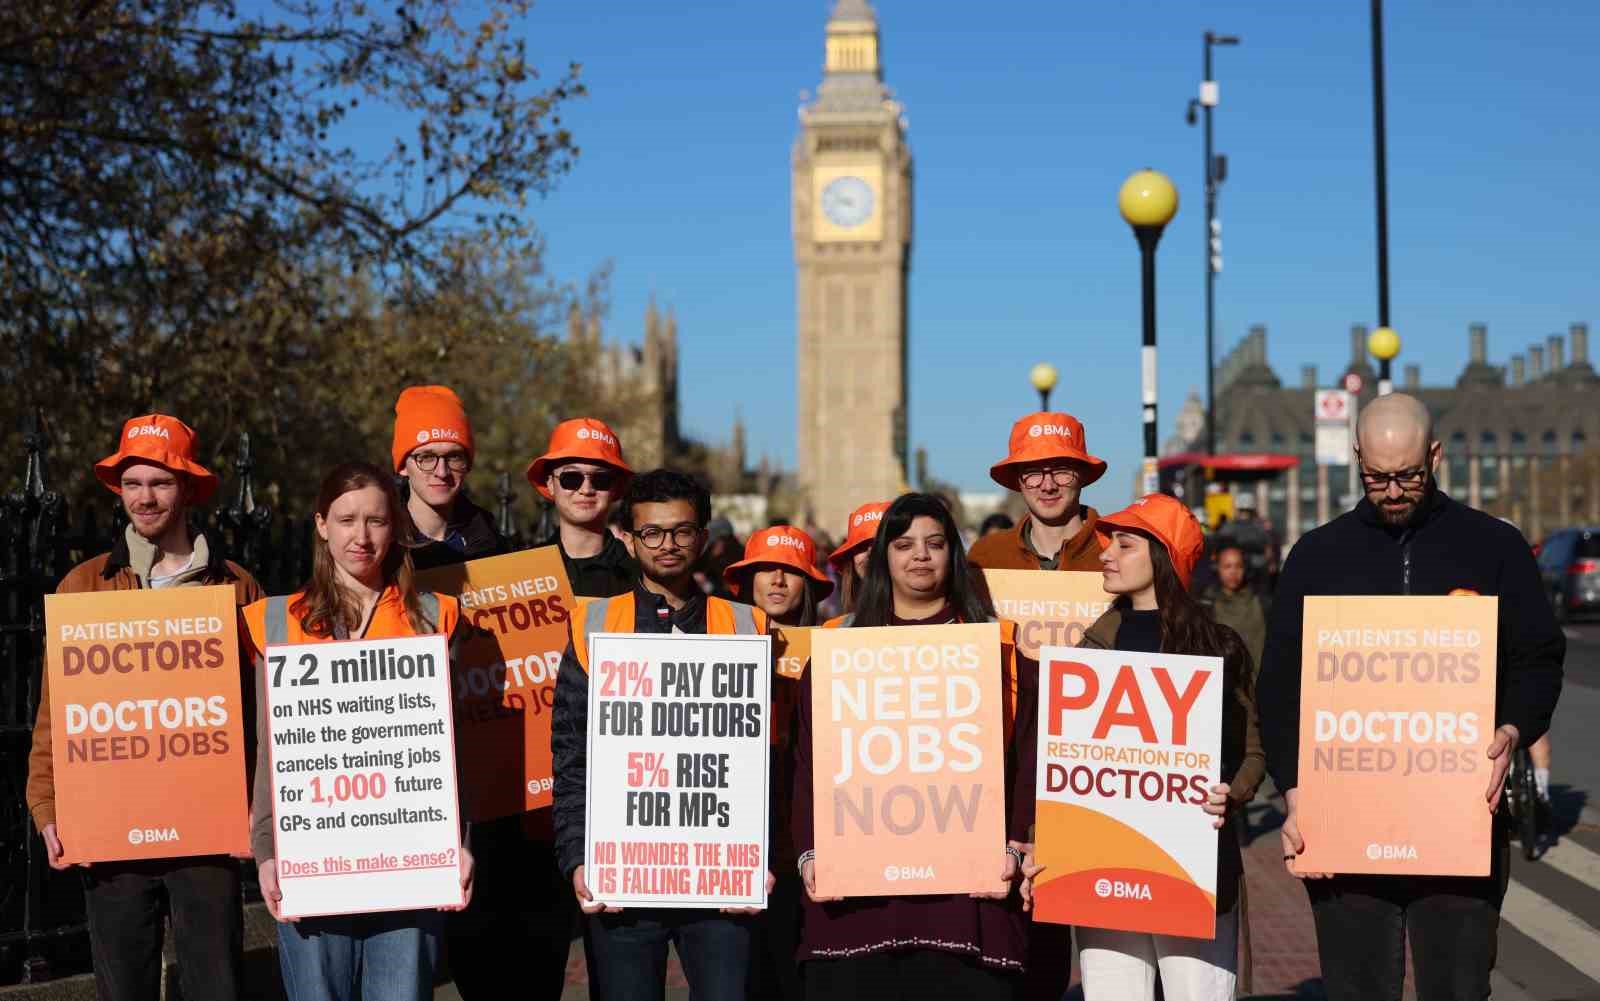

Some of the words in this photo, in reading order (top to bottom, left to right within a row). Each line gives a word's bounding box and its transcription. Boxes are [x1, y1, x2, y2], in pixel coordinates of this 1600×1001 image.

[140, 425, 169, 440] BMA
[1044, 424, 1072, 438] BMA
[864, 511, 884, 522] BM
[780, 535, 806, 552] BMA
[510, 576, 559, 598] NEED
[61, 619, 160, 641] PATIENTS
[165, 617, 223, 636] NEED
[464, 595, 568, 635] CTORS
[1318, 629, 1417, 648] PATIENTS
[1424, 629, 1481, 649] NEED
[63, 638, 224, 676] DOCTORS
[268, 653, 319, 688] 7.2
[331, 648, 436, 684] million
[831, 644, 980, 673] DOCTORS
[1316, 651, 1481, 684] DOCTORS
[600, 661, 653, 697] 21%
[661, 662, 705, 698] PAY
[712, 662, 758, 698] CUT
[273, 704, 293, 718] on
[298, 698, 332, 716] NHS
[337, 695, 395, 714] waiting
[399, 693, 436, 711] lists,
[831, 675, 981, 721] NEED
[1048, 660, 1212, 746] PAY
[65, 695, 228, 735] DOCTORS
[600, 701, 643, 736] FOR
[651, 701, 761, 737] DOCTORS
[1314, 710, 1480, 744] DOCTORS
[274, 728, 316, 745] while
[321, 725, 346, 742] the
[352, 719, 445, 744] government
[67, 735, 150, 763] NEED
[157, 730, 230, 762] JOBS
[276, 754, 338, 773] cancels
[342, 750, 404, 769] training
[408, 747, 441, 768] jobs
[833, 722, 983, 785] JOBS
[1047, 741, 1169, 768] RESTORATION
[1175, 751, 1211, 769] FOR
[627, 752, 669, 787] 5%
[676, 753, 729, 788] RISE
[1313, 748, 1397, 773] NEED
[1403, 748, 1478, 776] JOBS
[280, 786, 304, 802] for
[310, 772, 386, 808] 1,000
[394, 776, 443, 793] future
[1046, 763, 1211, 805] DOCTORS
[279, 815, 311, 832] GPs
[316, 812, 346, 829] and
[351, 806, 448, 827] consultants.
[626, 791, 671, 826] FOR
[679, 792, 730, 827] MPs
[833, 784, 983, 836] NOW
[145, 828, 180, 842] BMA
[281, 860, 319, 876] Does
[323, 856, 351, 873] this
[357, 853, 398, 870] make
[403, 848, 456, 866] sense?
[594, 841, 617, 865] NO
[621, 841, 689, 866] WONDER
[693, 842, 721, 867] THE
[726, 843, 760, 868] NHS
[1383, 845, 1418, 859] BMA
[598, 867, 617, 894] IS
[622, 867, 691, 894] FALLING
[696, 869, 754, 896] APART
[900, 865, 935, 880] BMA
[1114, 881, 1152, 901] BMA
